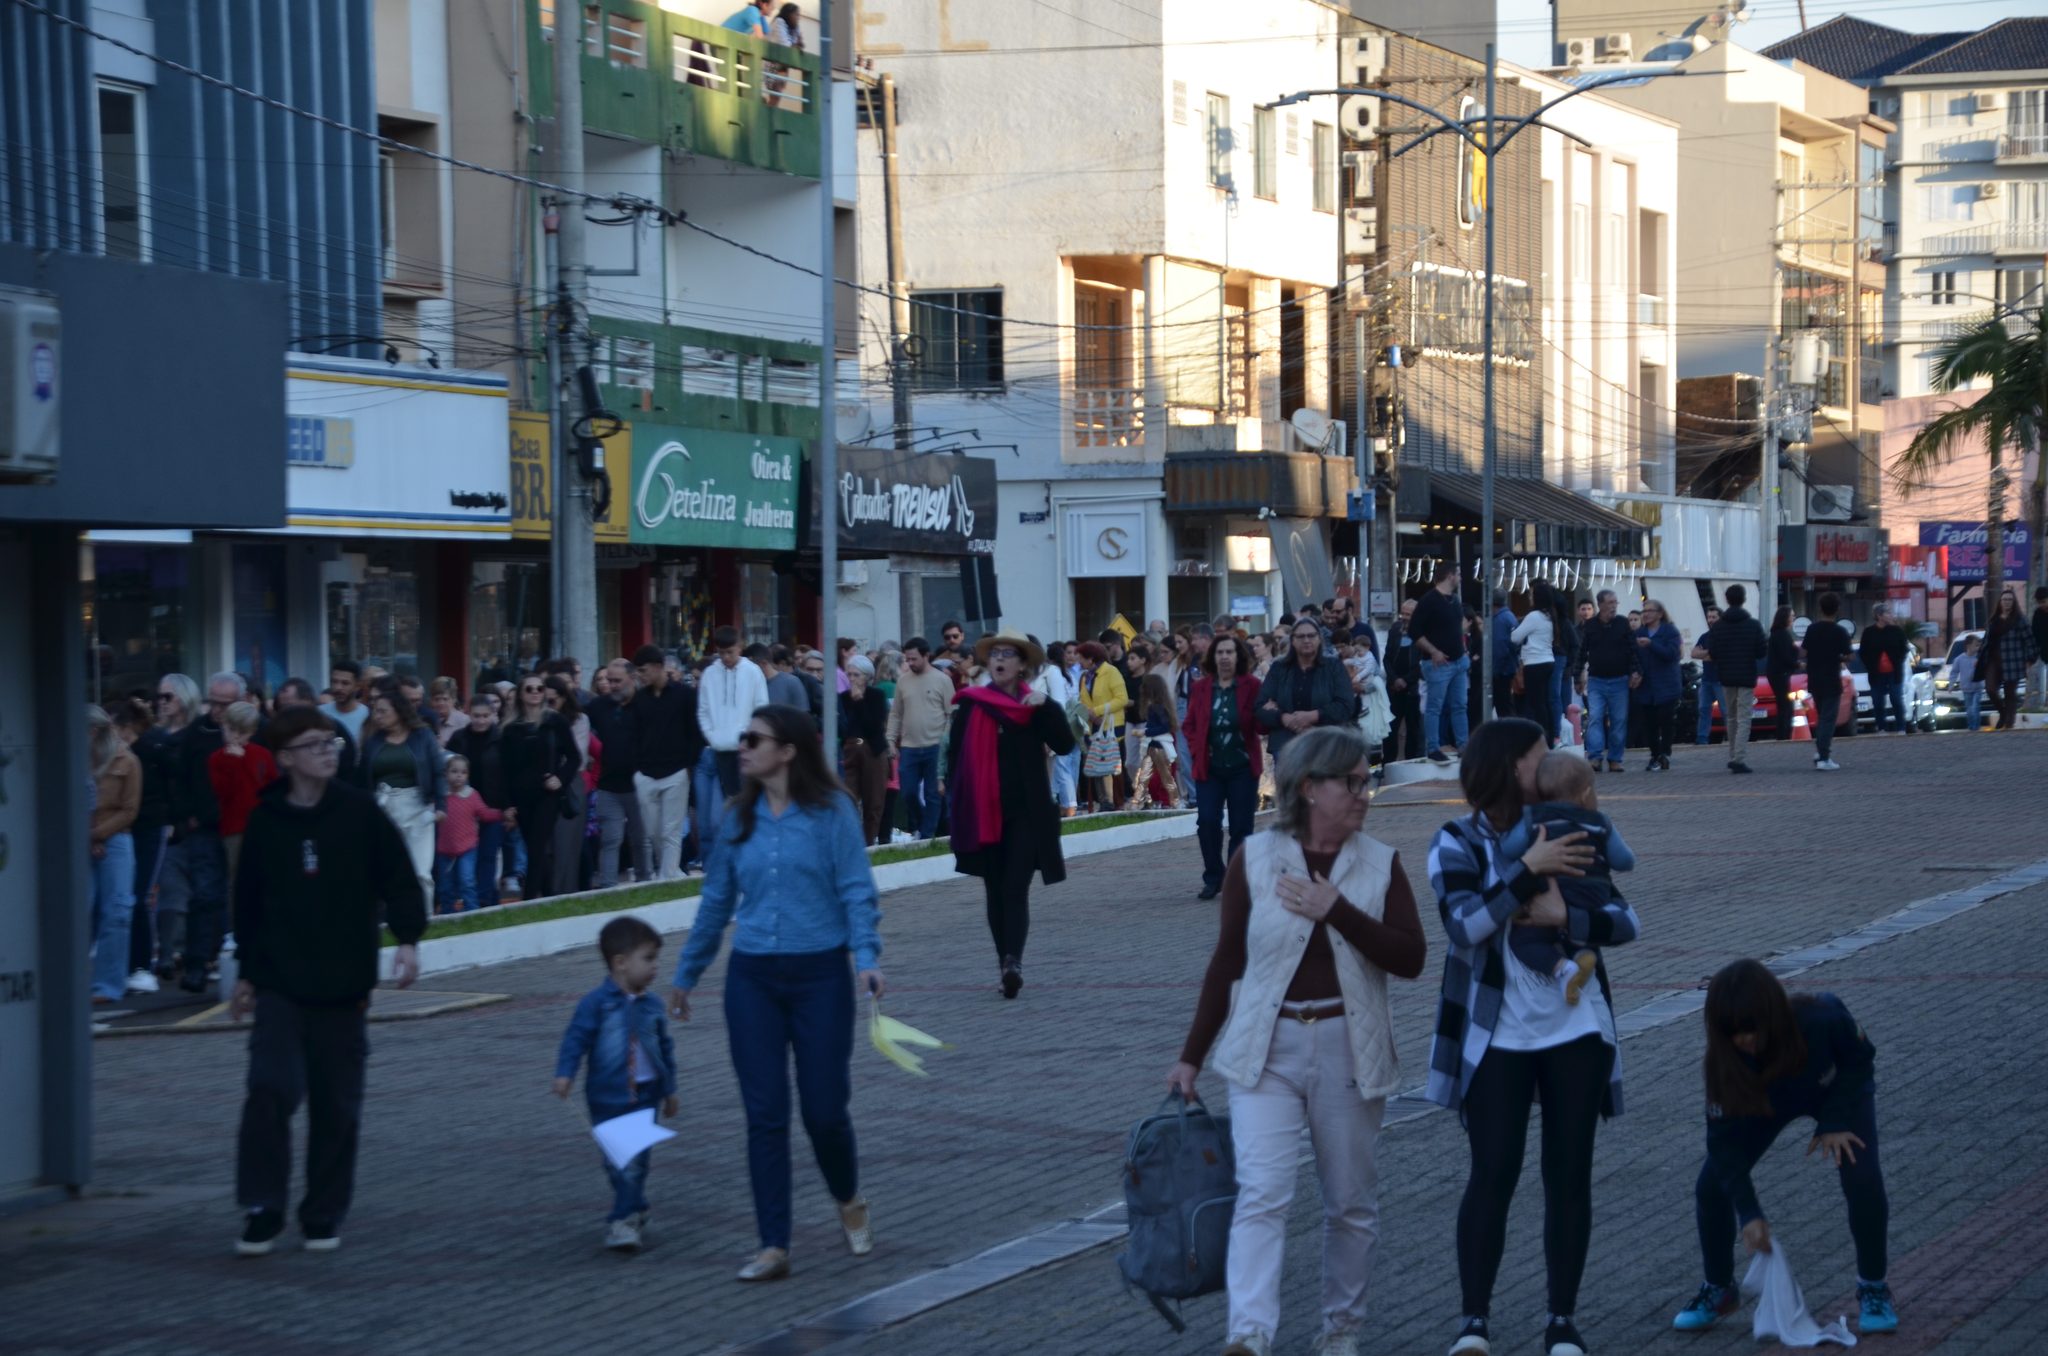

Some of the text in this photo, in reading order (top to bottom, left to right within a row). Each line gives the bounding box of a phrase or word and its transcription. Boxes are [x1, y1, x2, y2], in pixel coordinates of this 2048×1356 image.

[1340, 37, 1387, 311] HOTEL
[510, 430, 541, 460] Casa
[891, 482, 952, 531] TREVISOL
[1948, 546, 2025, 567] REL
